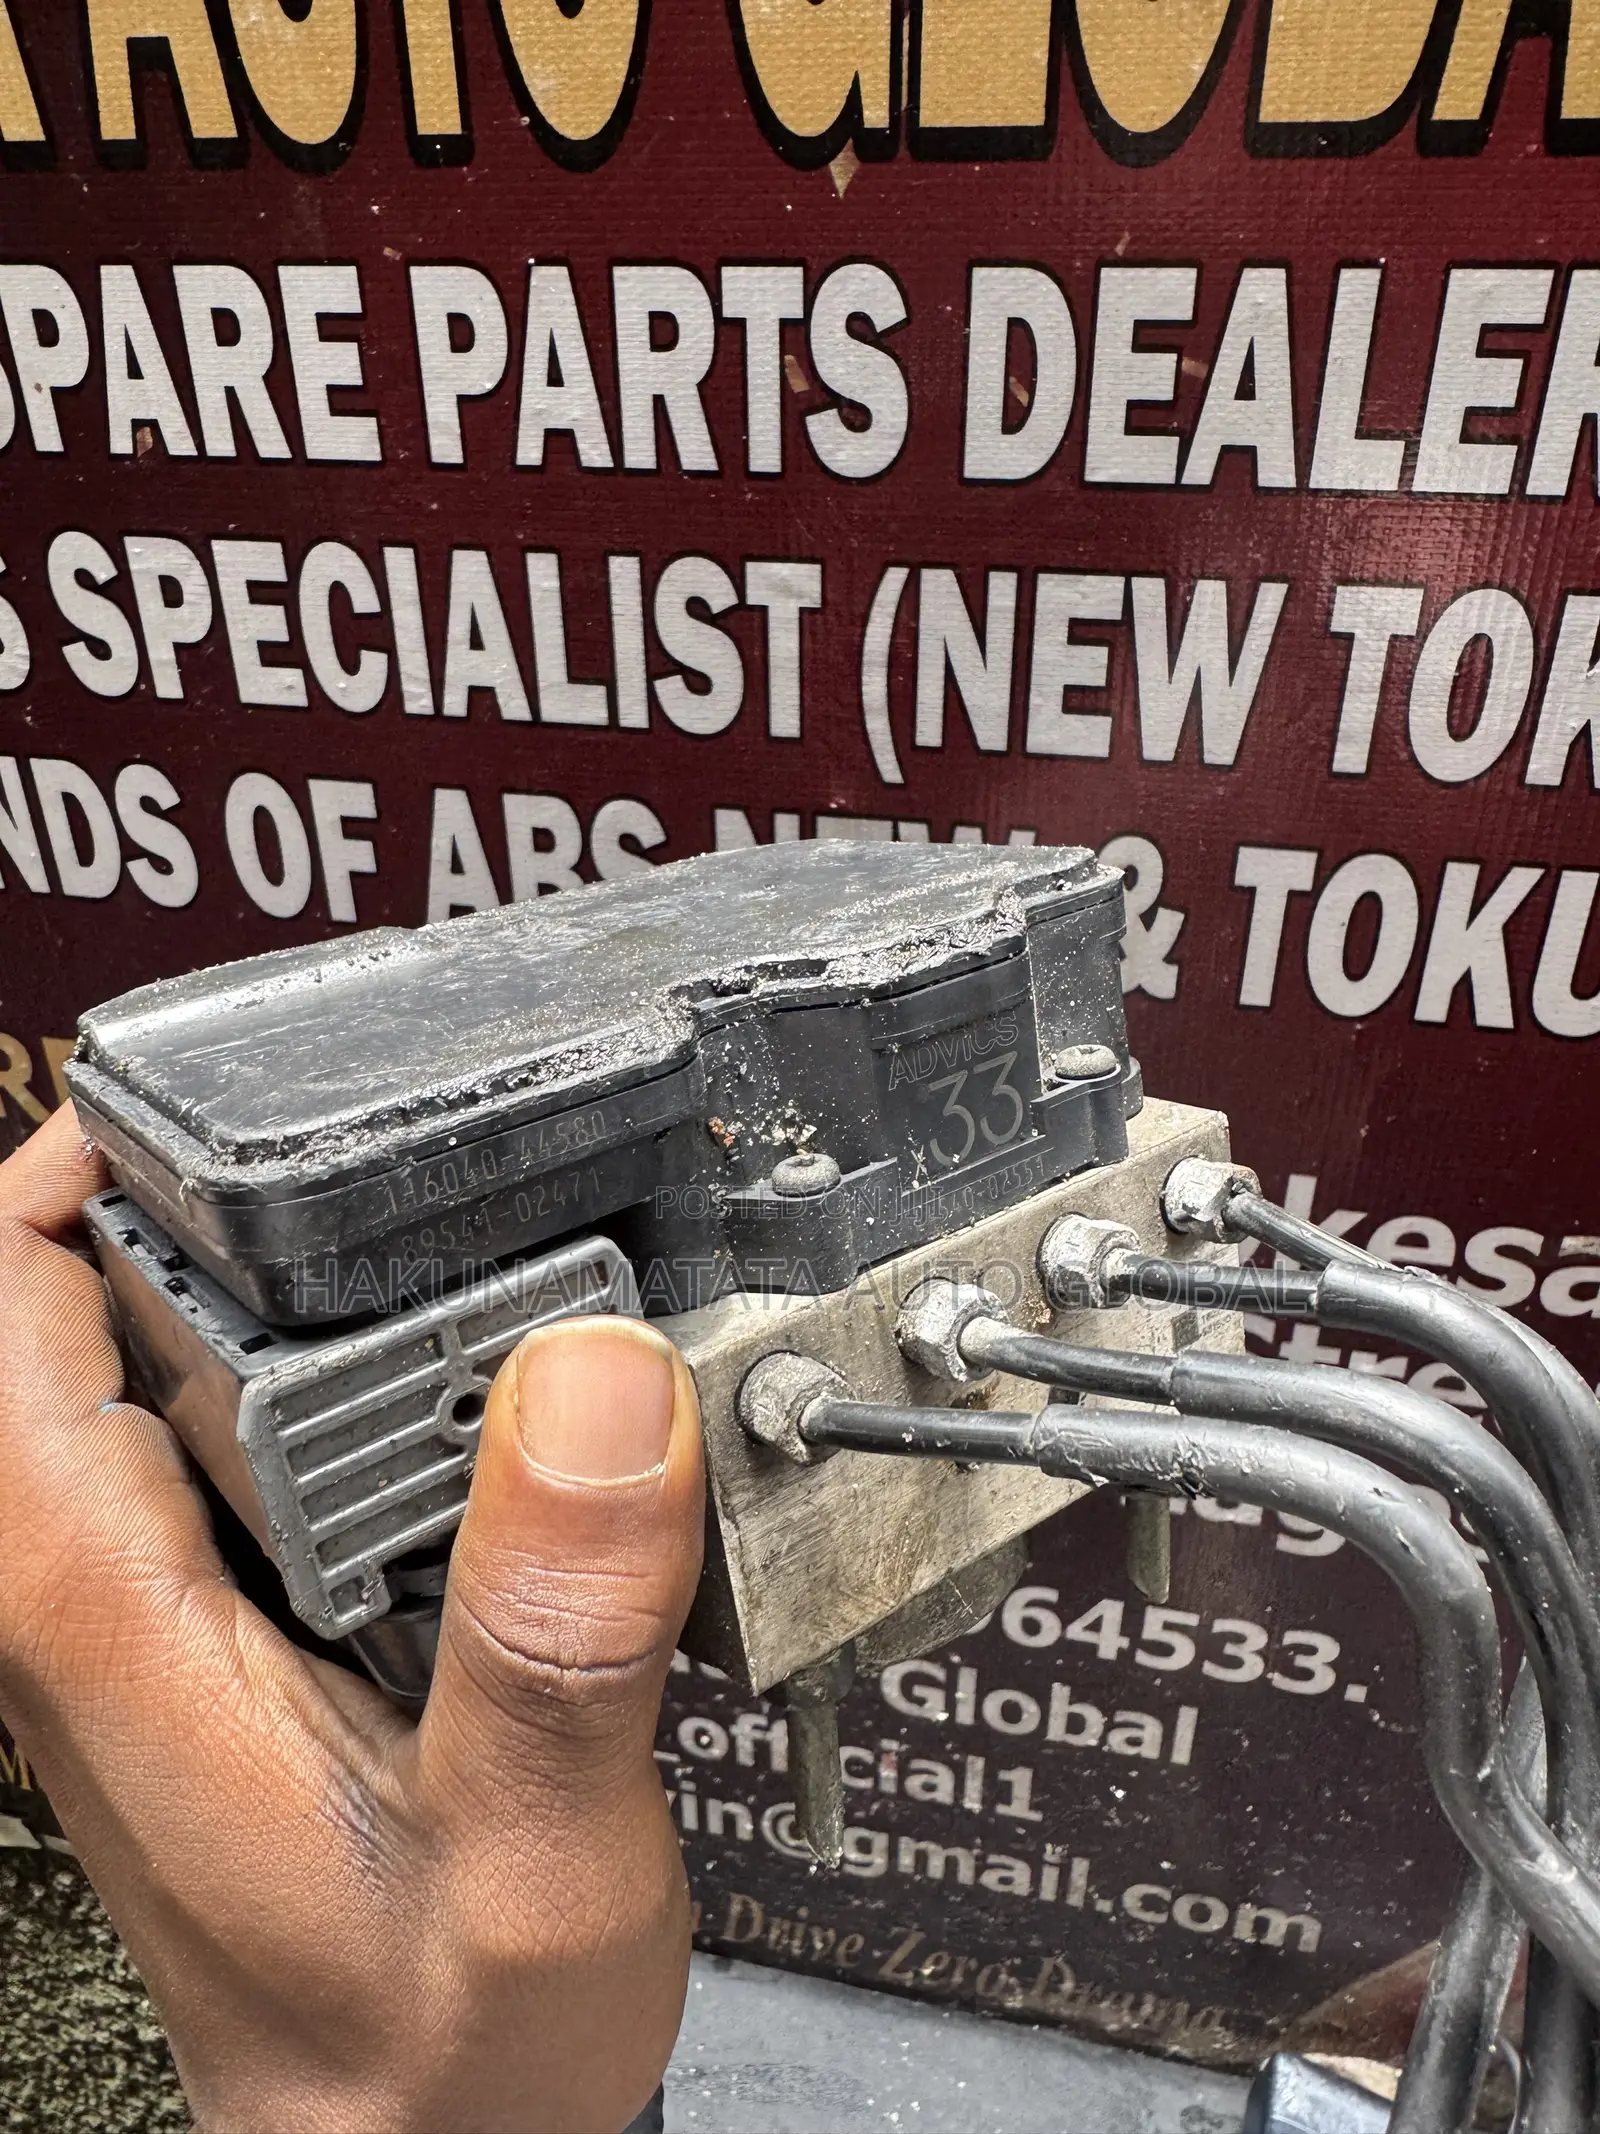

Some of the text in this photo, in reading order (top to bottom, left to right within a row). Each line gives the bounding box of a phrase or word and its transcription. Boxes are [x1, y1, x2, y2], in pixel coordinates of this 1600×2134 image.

[0, 264, 382, 462] PARE
[409, 263, 910, 480] PARTS
[48, 530, 822, 738] SPECIALIST
[861, 566, 1290, 786] (NEW
[224, 772, 379, 923] OF
[888, 1014, 1020, 1091] ADVICS
[922, 1050, 1025, 1167] 33
[966, 1586, 1369, 1703] 64533.
[653, 1713, 1043, 1823] _offcial1
[880, 1658, 1198, 1766] Global
[666, 1780, 1322, 1954] in@gmail.com
[876, 1927, 1007, 2006] Zero
